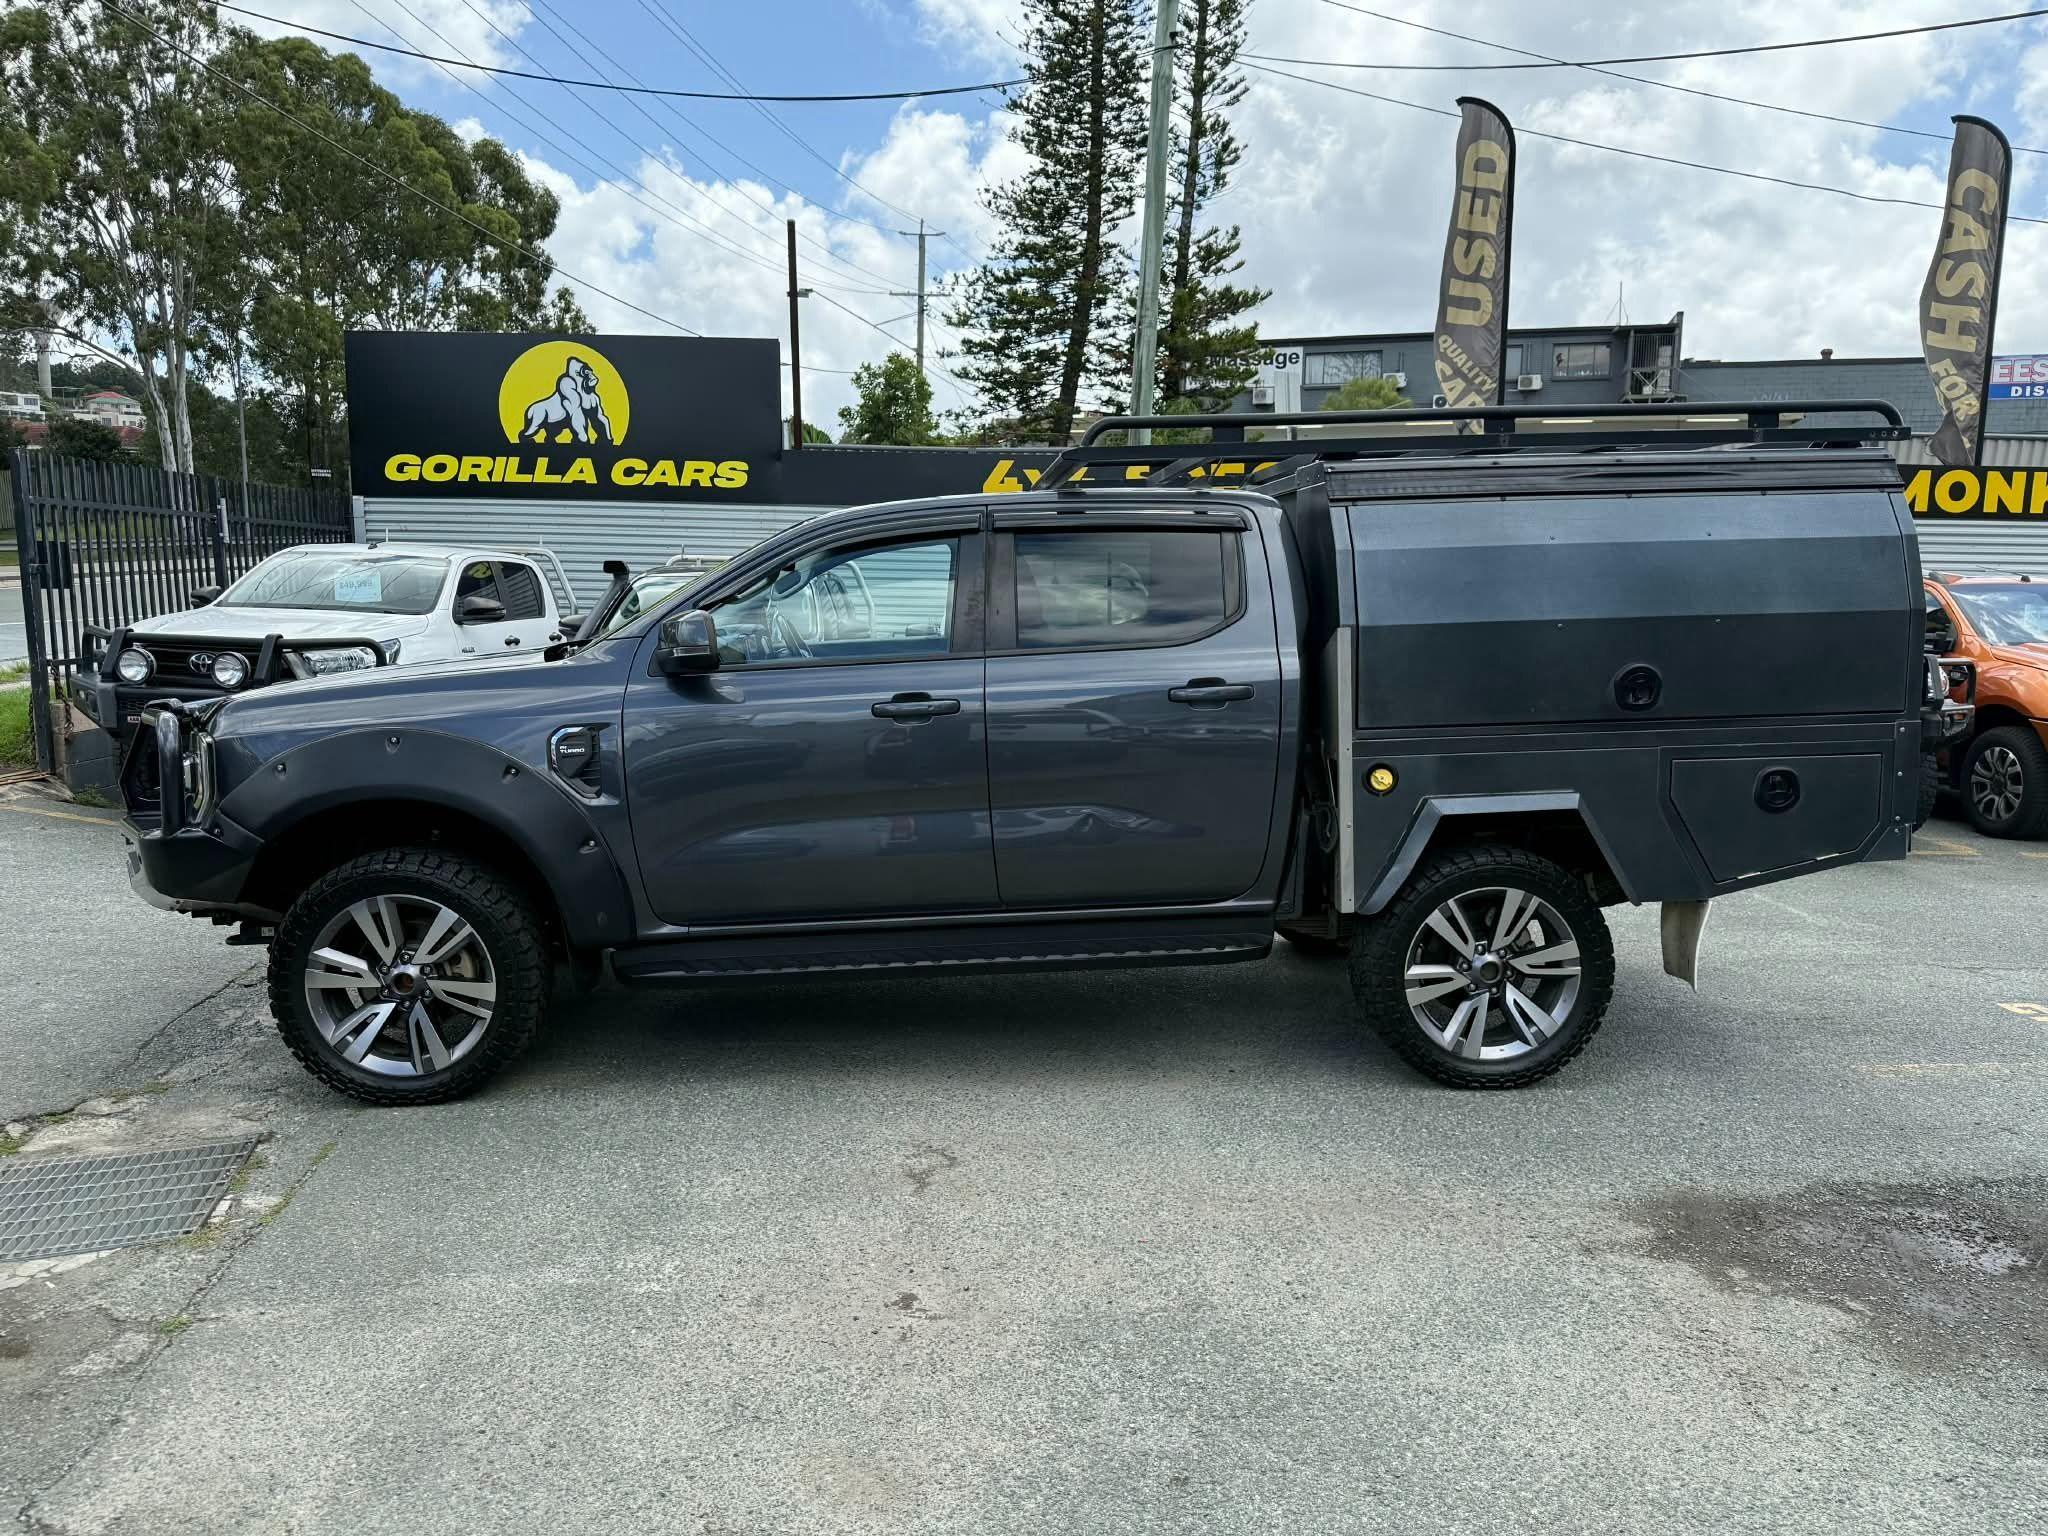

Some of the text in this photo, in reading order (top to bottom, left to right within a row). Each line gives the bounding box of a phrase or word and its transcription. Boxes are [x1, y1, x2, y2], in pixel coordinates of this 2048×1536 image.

[1446, 139, 1508, 327] USED
[1926, 168, 1998, 353] CASH
[1438, 334, 1497, 392] QUALITY
[1929, 359, 1980, 421] FOR
[384, 454, 750, 489] GORILLA CARS
